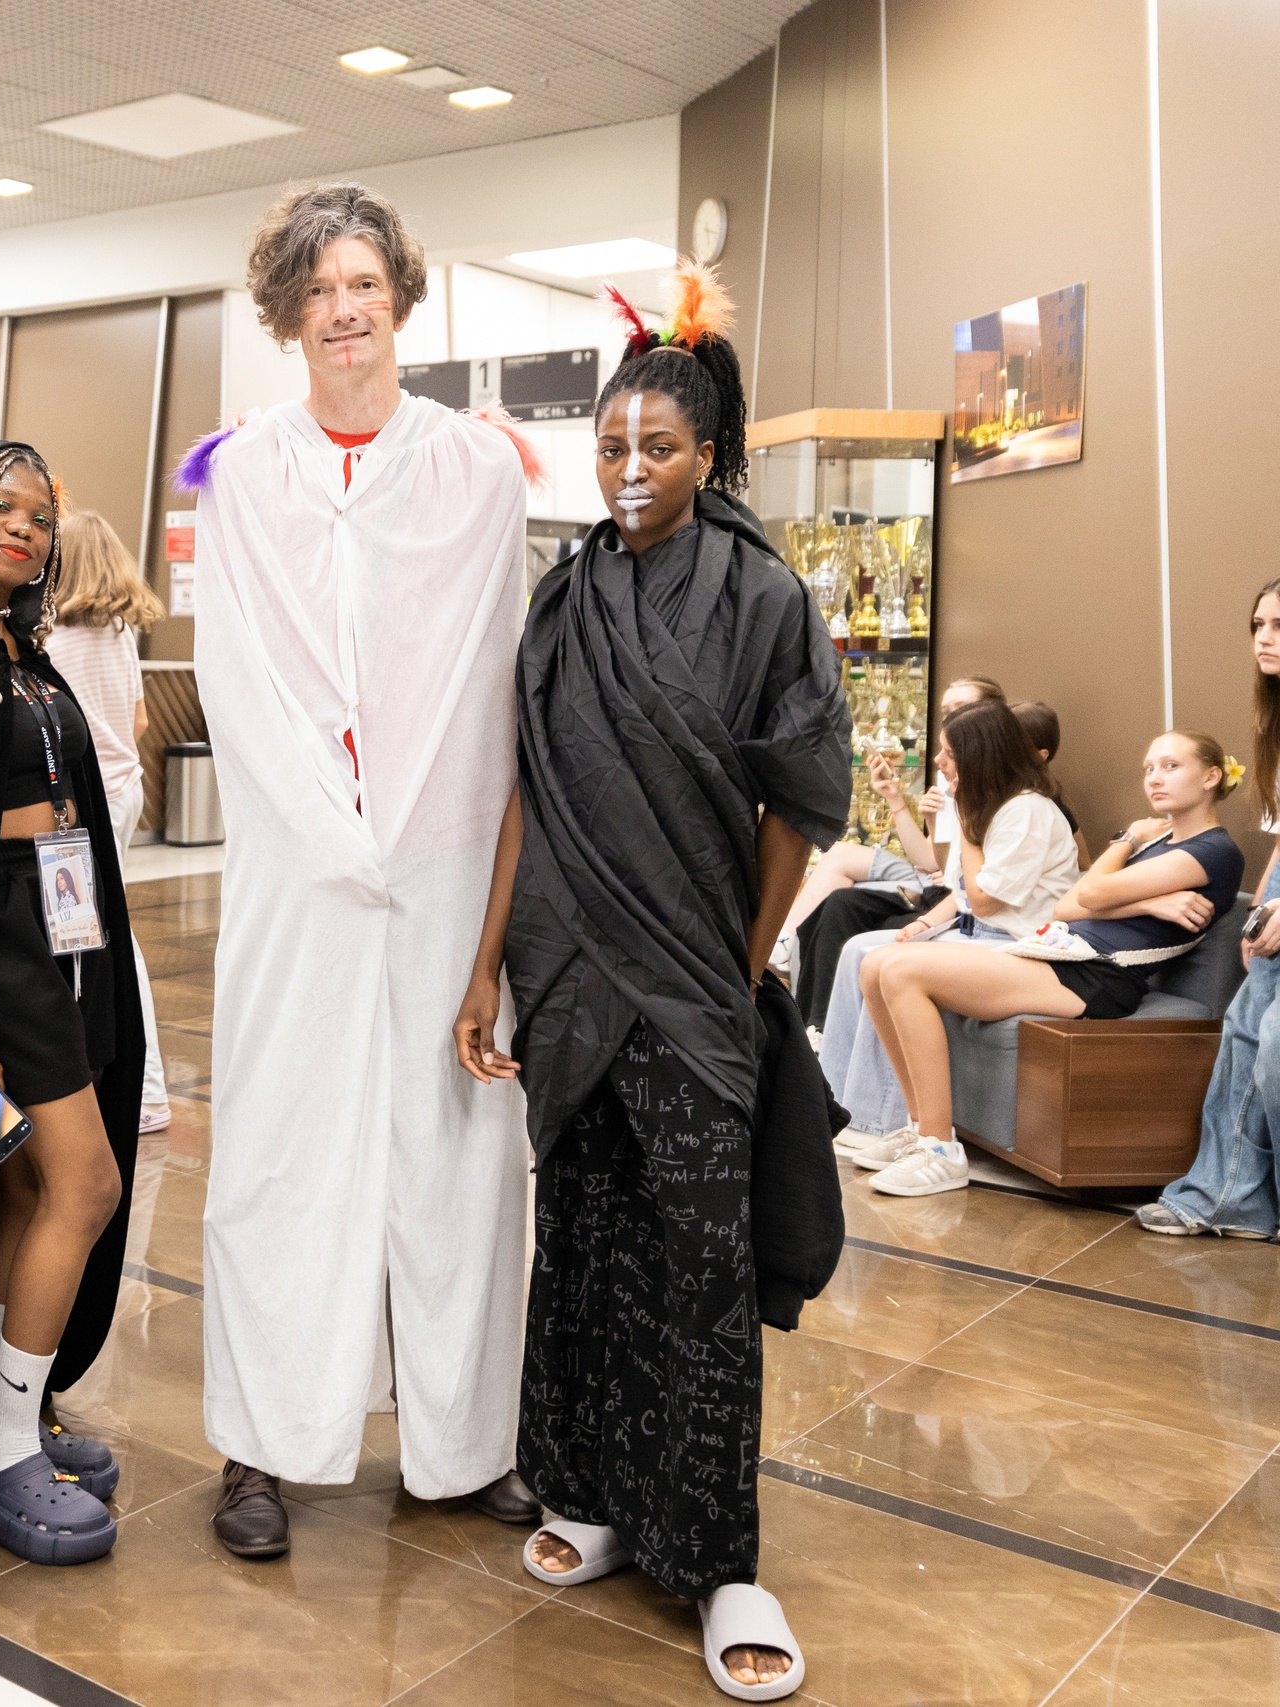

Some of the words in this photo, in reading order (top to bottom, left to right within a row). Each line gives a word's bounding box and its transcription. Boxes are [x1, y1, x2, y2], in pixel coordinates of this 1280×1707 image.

[478, 361, 488, 389] 1
[40, 726, 51, 748] CAMP
[45, 749, 56, 773] ENJOY
